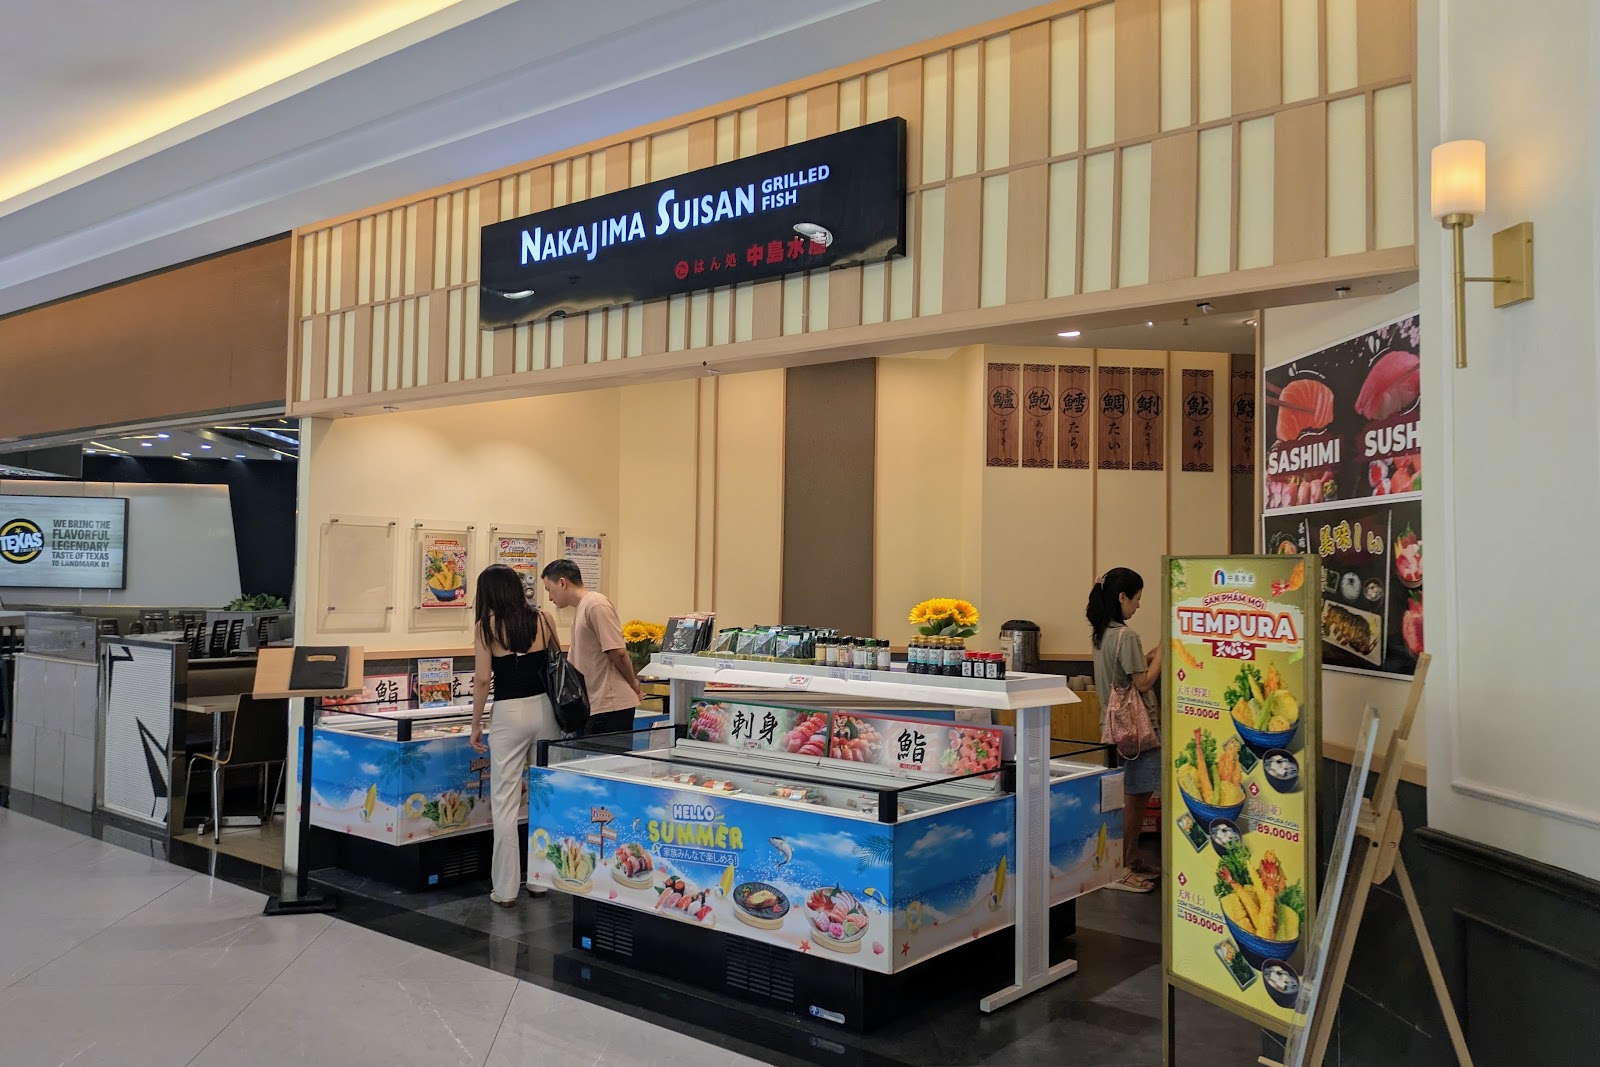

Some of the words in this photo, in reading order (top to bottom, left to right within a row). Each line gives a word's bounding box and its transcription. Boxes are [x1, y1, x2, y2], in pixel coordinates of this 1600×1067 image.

[762, 165, 829, 194] GRILLED
[762, 190, 797, 211] FISH
[521, 212, 646, 265] NAKAJIMA
[656, 184, 755, 235] SUISAN
[747, 232, 828, 267] 中島水産
[1268, 439, 1340, 476] SASHIMI
[52, 529, 111, 541] FLAVORFUL
[53, 520, 68, 529] WE
[69, 520, 94, 529] BRING
[96, 521, 111, 530] THE
[0, 532, 43, 553] TEXAS
[52, 540, 110, 551] LEGENDARY
[1318, 519, 1385, 558] 美味しい
[51, 551, 75, 560] TASTE
[75, 552, 85, 560] OF
[86, 552, 110, 561] TEXAS
[51, 560, 61, 568] TO
[61, 560, 100, 568] LANDMARK
[1178, 610, 1297, 641] TEMPURA
[374, 680, 399, 705] 鮨
[1185, 705, 1220, 720] 59.000đ
[731, 710, 778, 745] 刺身
[897, 728, 927, 764] 鮨
[673, 804, 715, 822] HELLO
[648, 820, 744, 849] SUMMER
[1257, 823, 1300, 843] 89.000đ
[1184, 911, 1224, 935] 139.000đ
